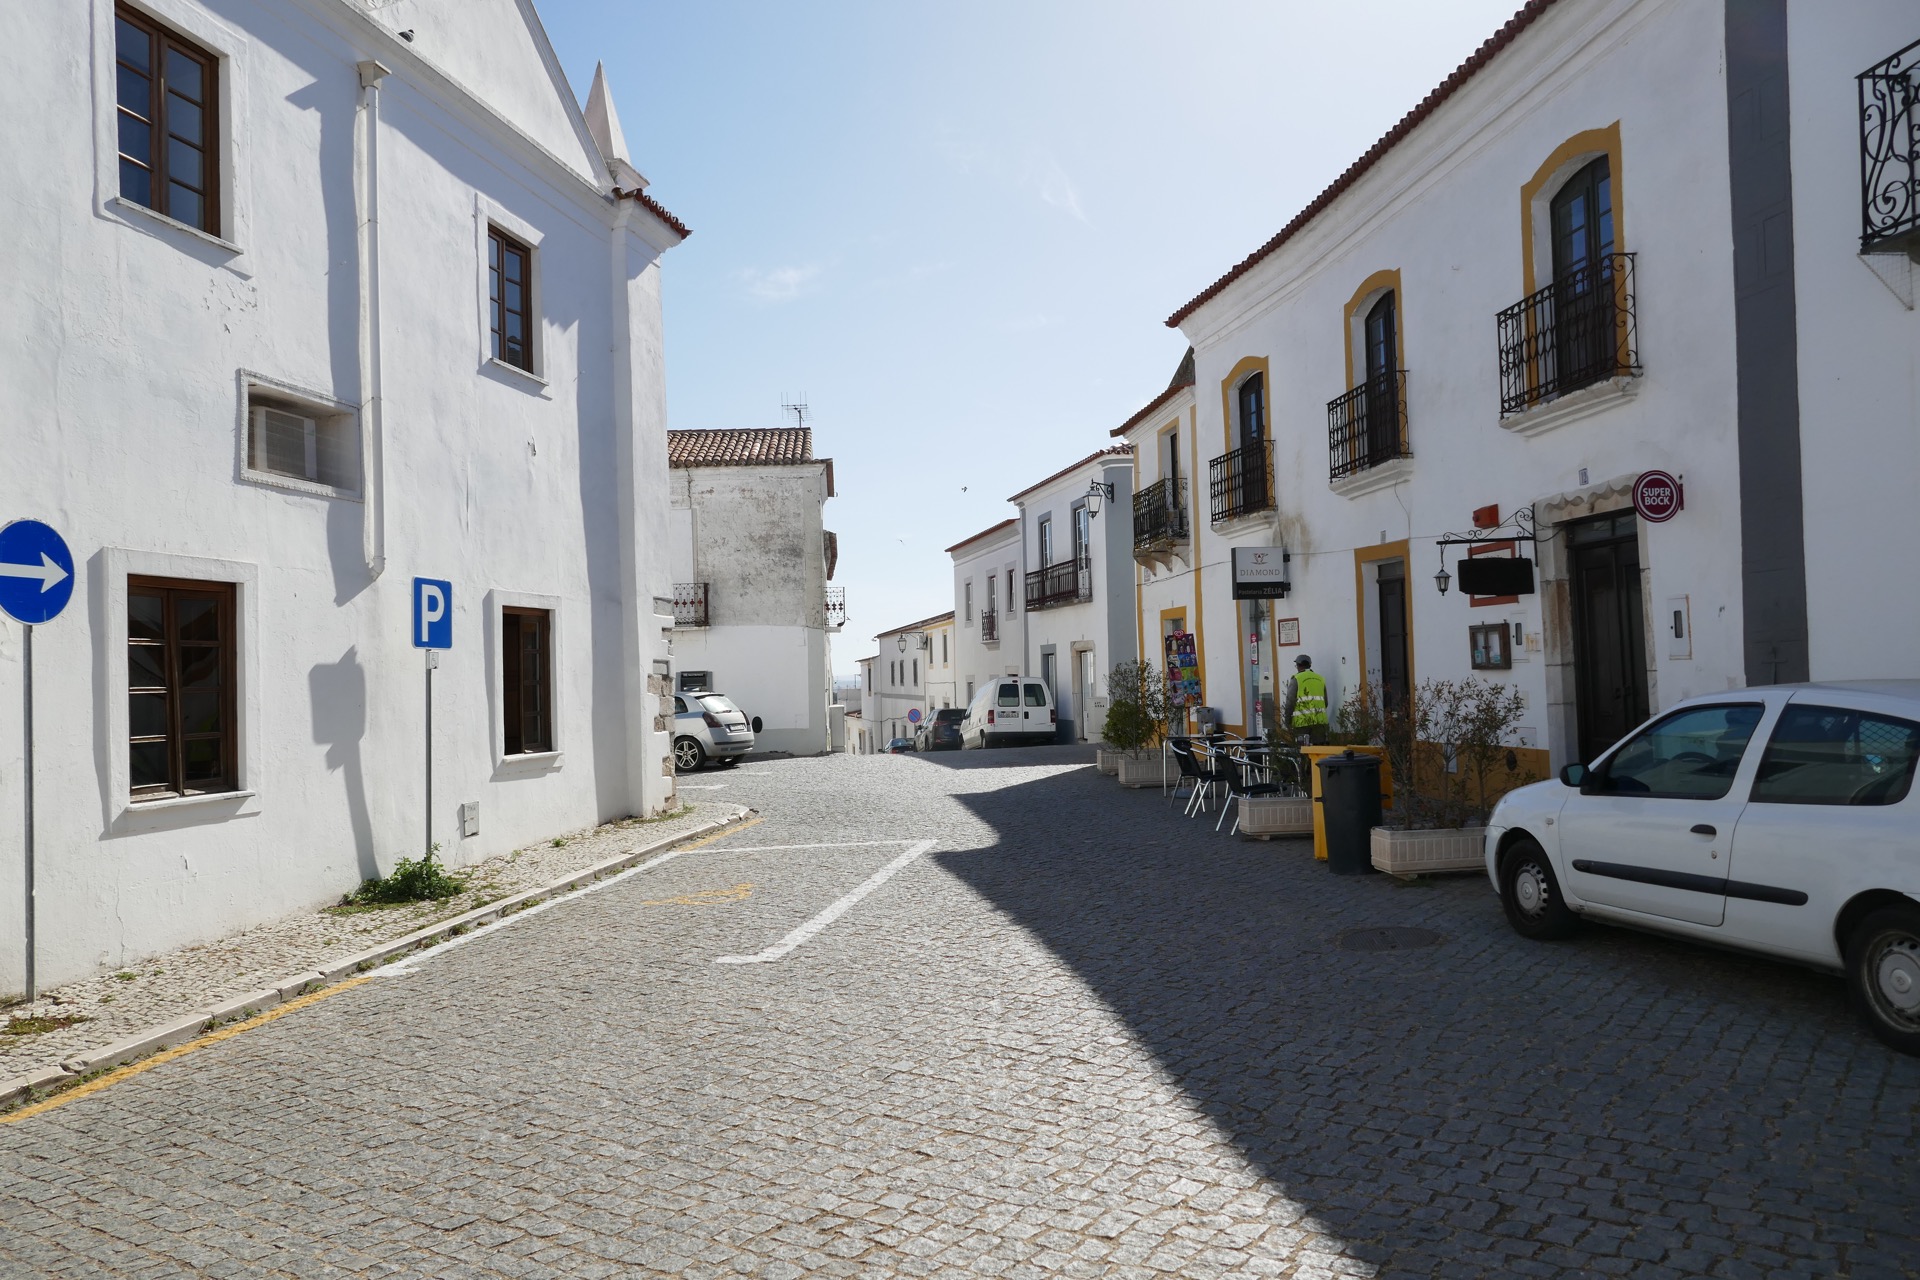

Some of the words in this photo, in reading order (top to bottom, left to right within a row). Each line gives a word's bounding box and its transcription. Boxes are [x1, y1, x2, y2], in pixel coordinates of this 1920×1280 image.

[1643, 487, 1671, 497] SUPER
[1644, 496, 1670, 506] BOCK
[1240, 569, 1280, 577] DIAMOND
[1263, 586, 1283, 595] ZÉLIA
[421, 584, 445, 642] P
